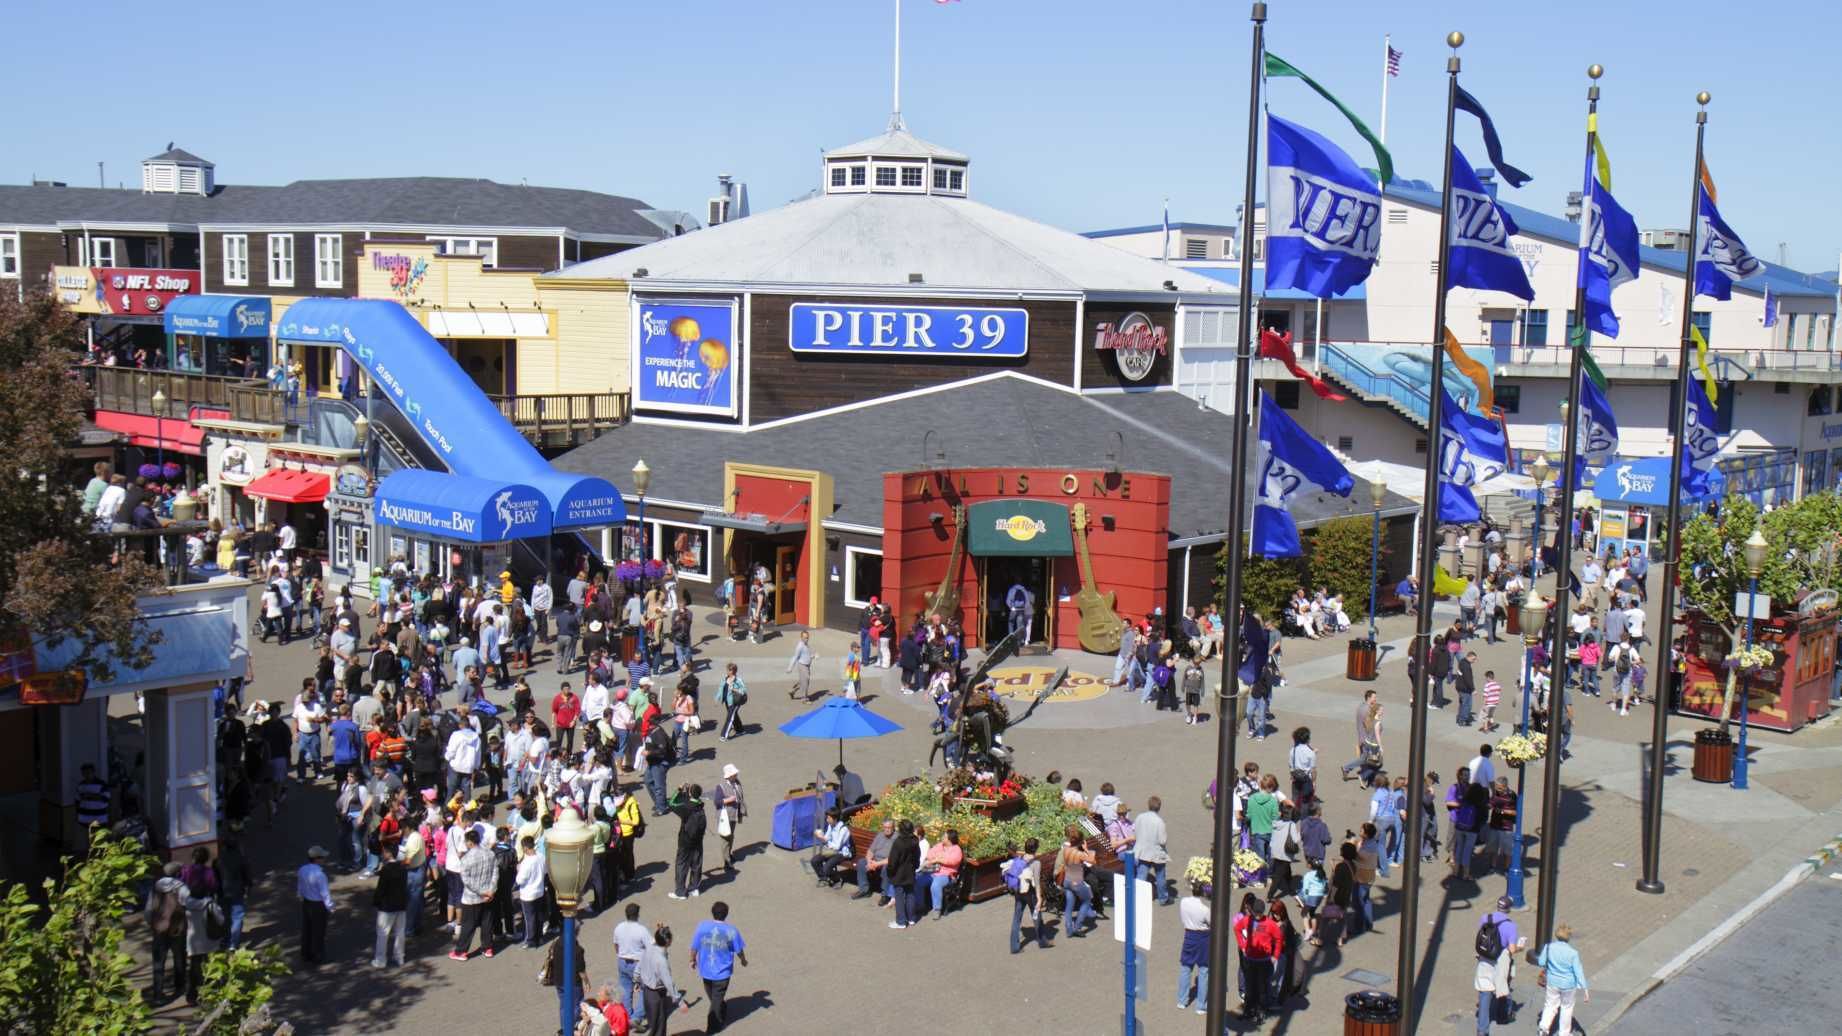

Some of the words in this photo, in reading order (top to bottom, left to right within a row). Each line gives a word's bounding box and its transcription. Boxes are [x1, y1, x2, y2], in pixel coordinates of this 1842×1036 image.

[1289, 175, 1380, 252] PIER
[126, 274, 152, 289] NFL
[155, 275, 190, 292] Shop
[811, 309, 937, 348] PIER
[951, 313, 1006, 350] 39
[1095, 322, 1137, 351] Hard
[645, 356, 681, 368] EXPERIENCE
[683, 359, 696, 369] THE
[655, 369, 702, 390] MAGIC
[438, 436, 453, 454] Pool
[918, 475, 970, 498] ALL
[998, 474, 1029, 495] IS
[1060, 473, 1131, 499] ONE
[1631, 480, 1655, 493] BAY
[568, 496, 614, 510] AQUARIUM
[380, 499, 432, 526] AQUARIUM
[452, 511, 476, 533] BAY
[514, 510, 539, 525] BAY
[569, 507, 613, 520] ENTRANCE
[996, 518, 1025, 530] Hard
[1023, 519, 1047, 533] Rock
